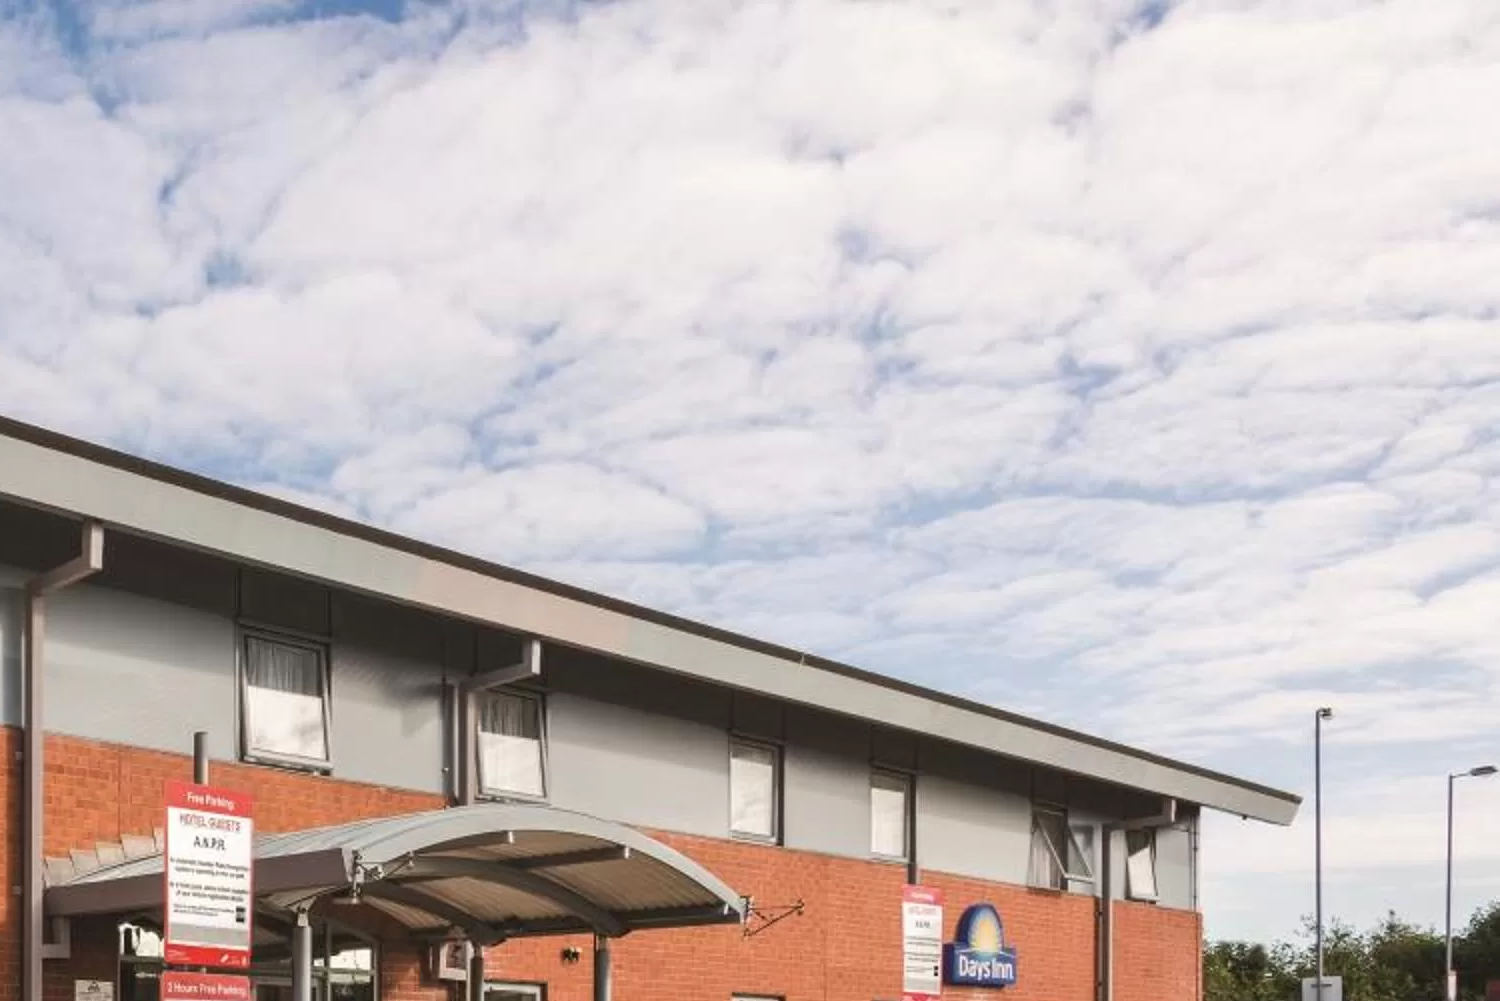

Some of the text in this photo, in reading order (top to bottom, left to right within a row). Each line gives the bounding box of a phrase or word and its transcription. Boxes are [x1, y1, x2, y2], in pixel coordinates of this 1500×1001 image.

[959, 955, 991, 981] Days
[991, 957, 1015, 980] Inn
[173, 982, 198, 993] Hours
[199, 983, 217, 994] Free
[217, 984, 247, 998] Parking
